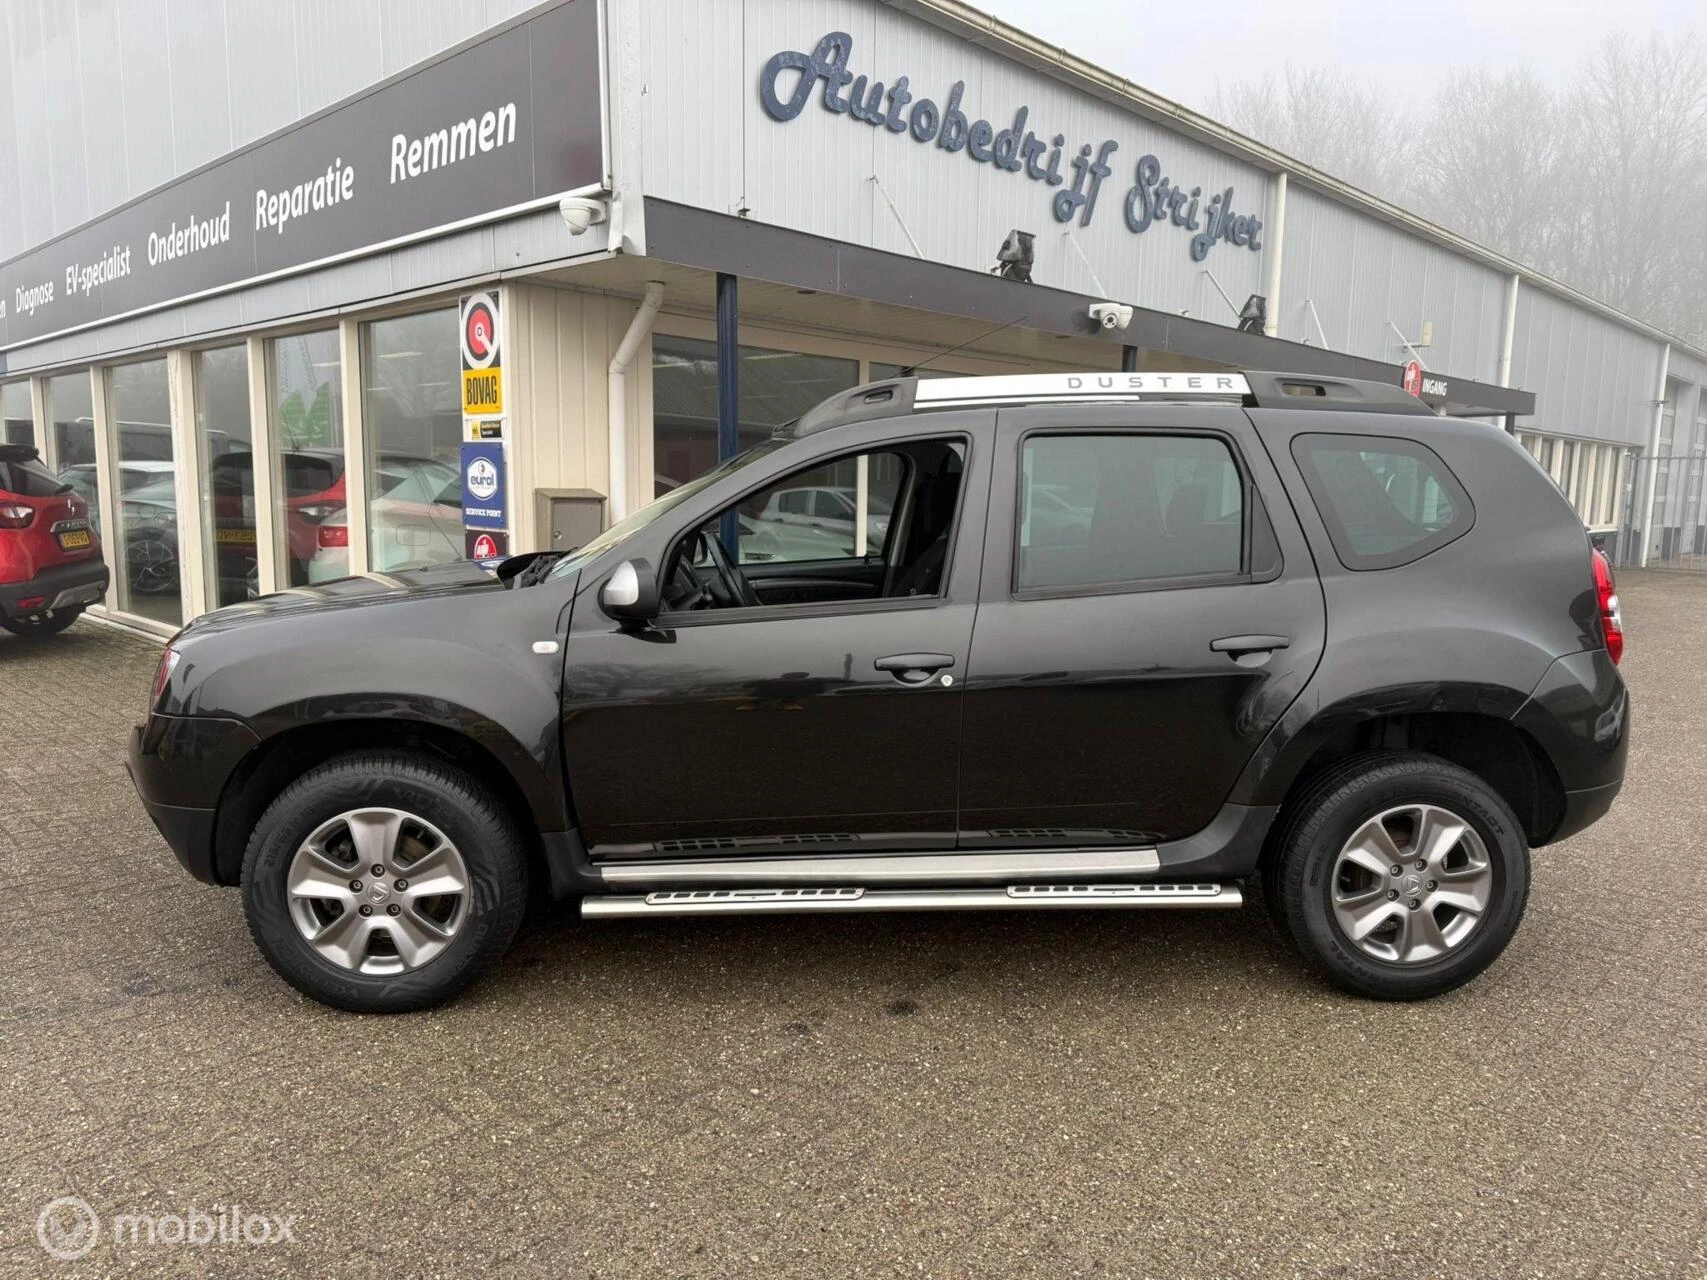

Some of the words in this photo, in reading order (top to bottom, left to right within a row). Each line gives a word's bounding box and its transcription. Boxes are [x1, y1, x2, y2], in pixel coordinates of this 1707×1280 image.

[760, 31, 1118, 227] Autobedrijf
[1126, 154, 1262, 262] Strijker
[15, 280, 54, 316] Diagnose
[66, 244, 131, 296] EV-specialist
[148, 201, 231, 267] Onderhoud
[256, 158, 354, 234] Reparatie
[390, 102, 517, 184] Remmen
[466, 375, 498, 405] BOVAG
[1068, 376, 1233, 389] DUSTER
[1422, 379, 1447, 396] INGANG
[470, 473, 495, 486] eurol
[465, 507, 486, 516] SERVICE
[487, 509, 502, 518] POINT
